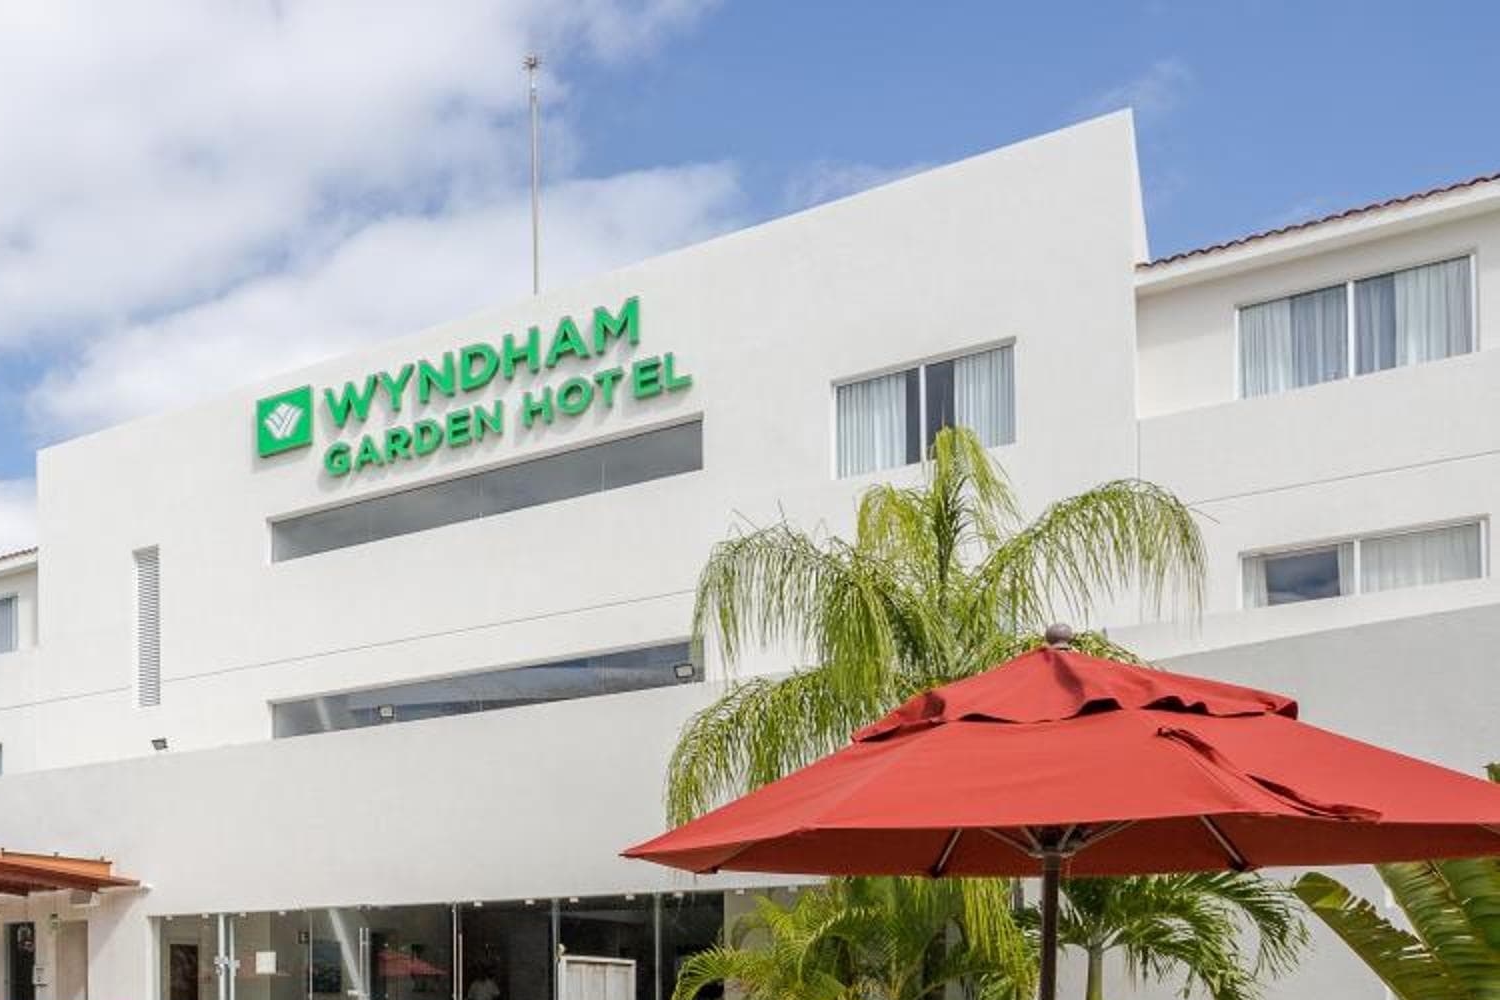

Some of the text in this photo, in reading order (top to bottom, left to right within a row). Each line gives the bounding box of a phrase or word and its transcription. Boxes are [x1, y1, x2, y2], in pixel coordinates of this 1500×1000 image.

[323, 352, 693, 477] GARDEN HOTEL
[324, 297, 641, 428] WYNDHAM
